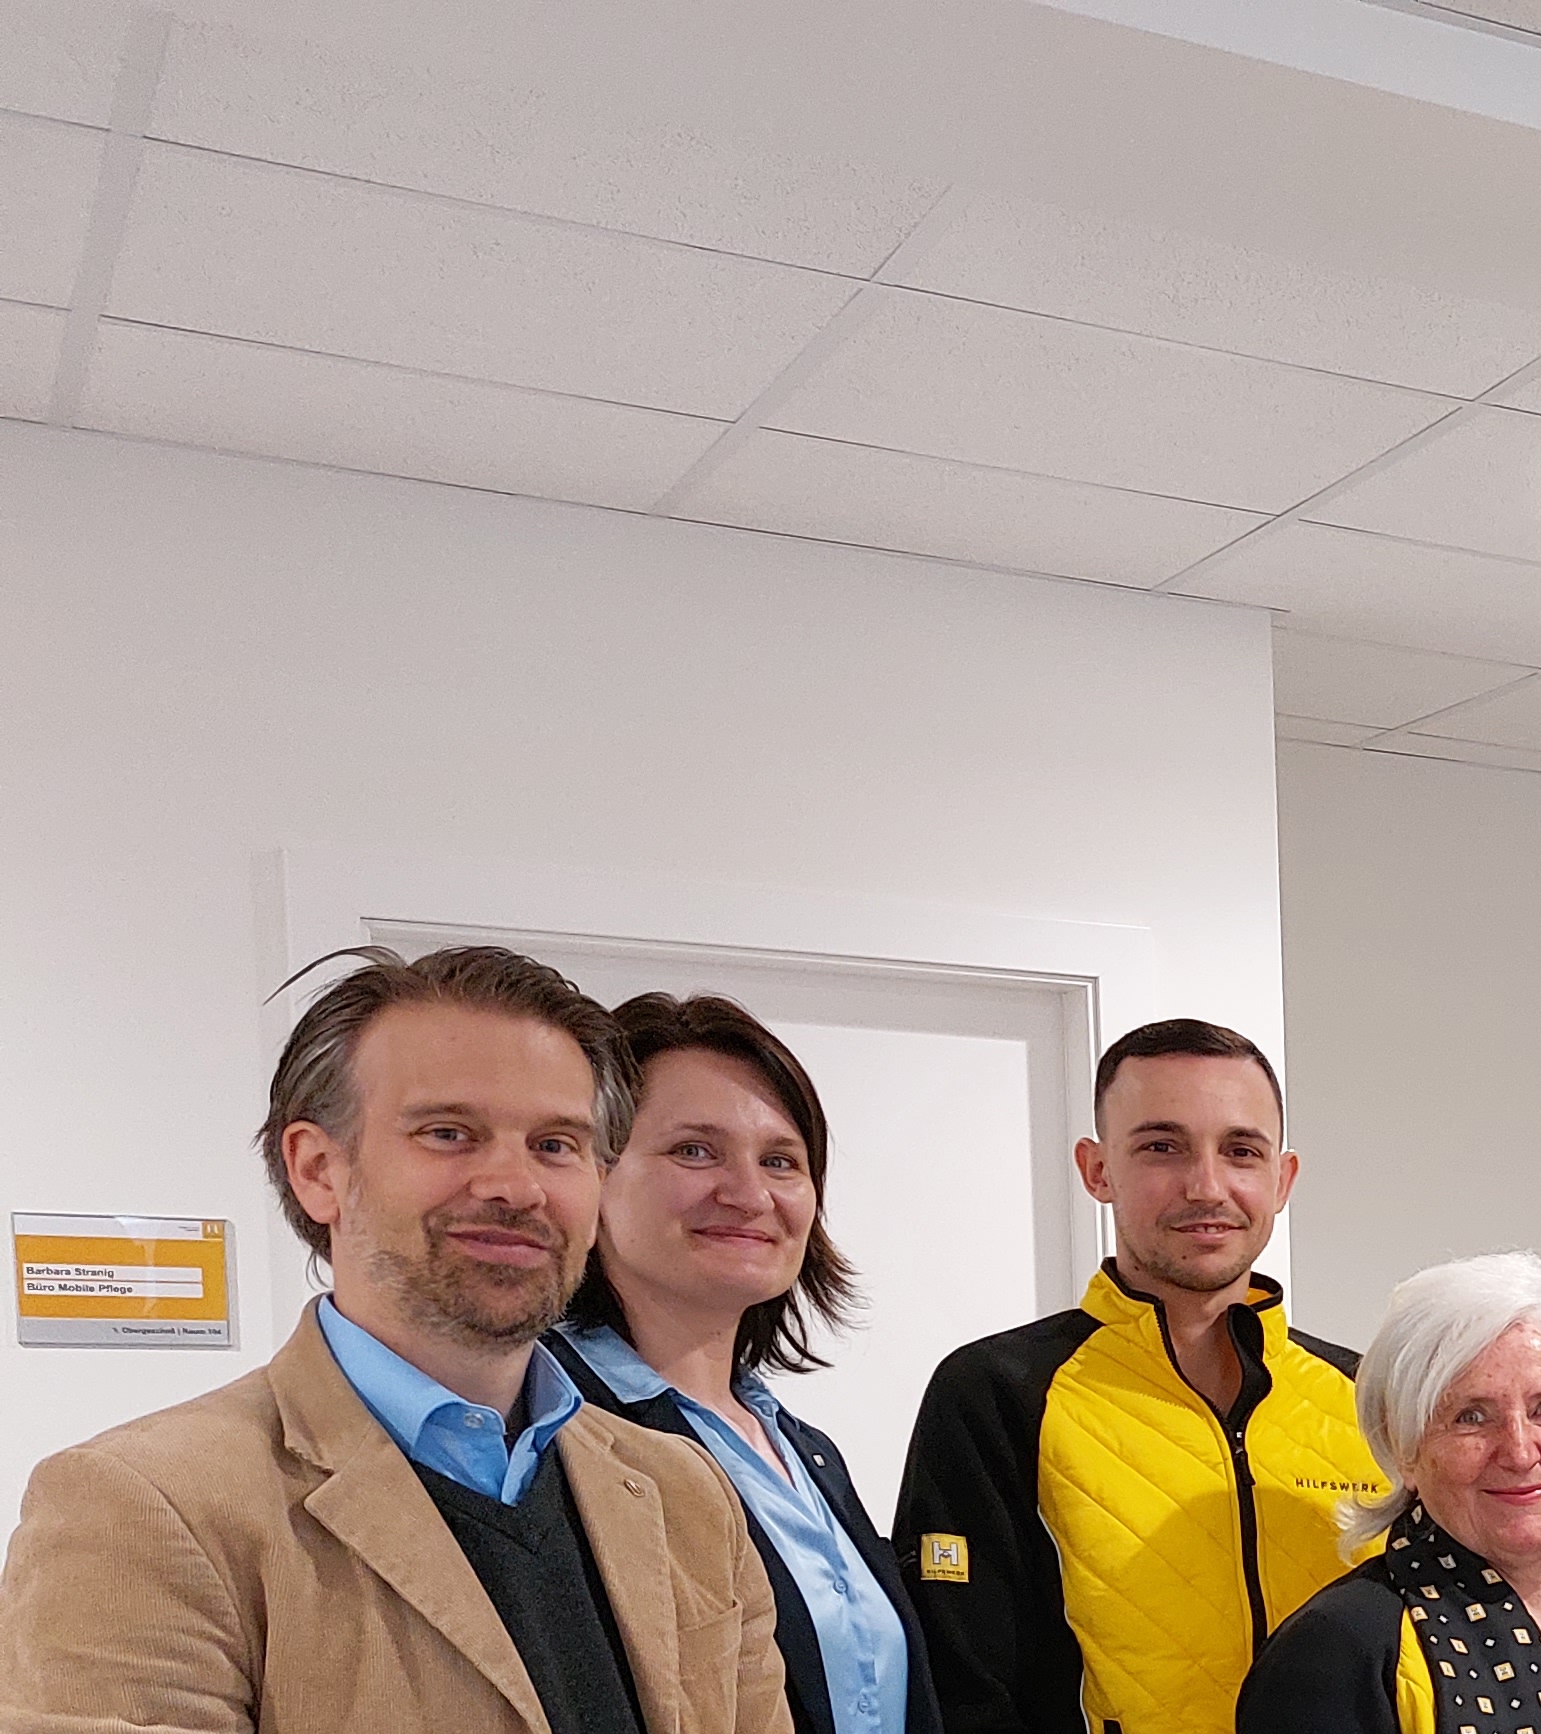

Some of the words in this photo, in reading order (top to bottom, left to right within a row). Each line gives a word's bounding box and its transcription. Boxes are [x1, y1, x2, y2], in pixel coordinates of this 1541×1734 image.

[26, 1266, 71, 1276] Barbara
[26, 1282, 55, 1292] Büro
[58, 1283, 96, 1293] Mobile
[98, 1284, 134, 1295] Pflege
[1295, 1477, 1379, 1494] HILFSWERK
